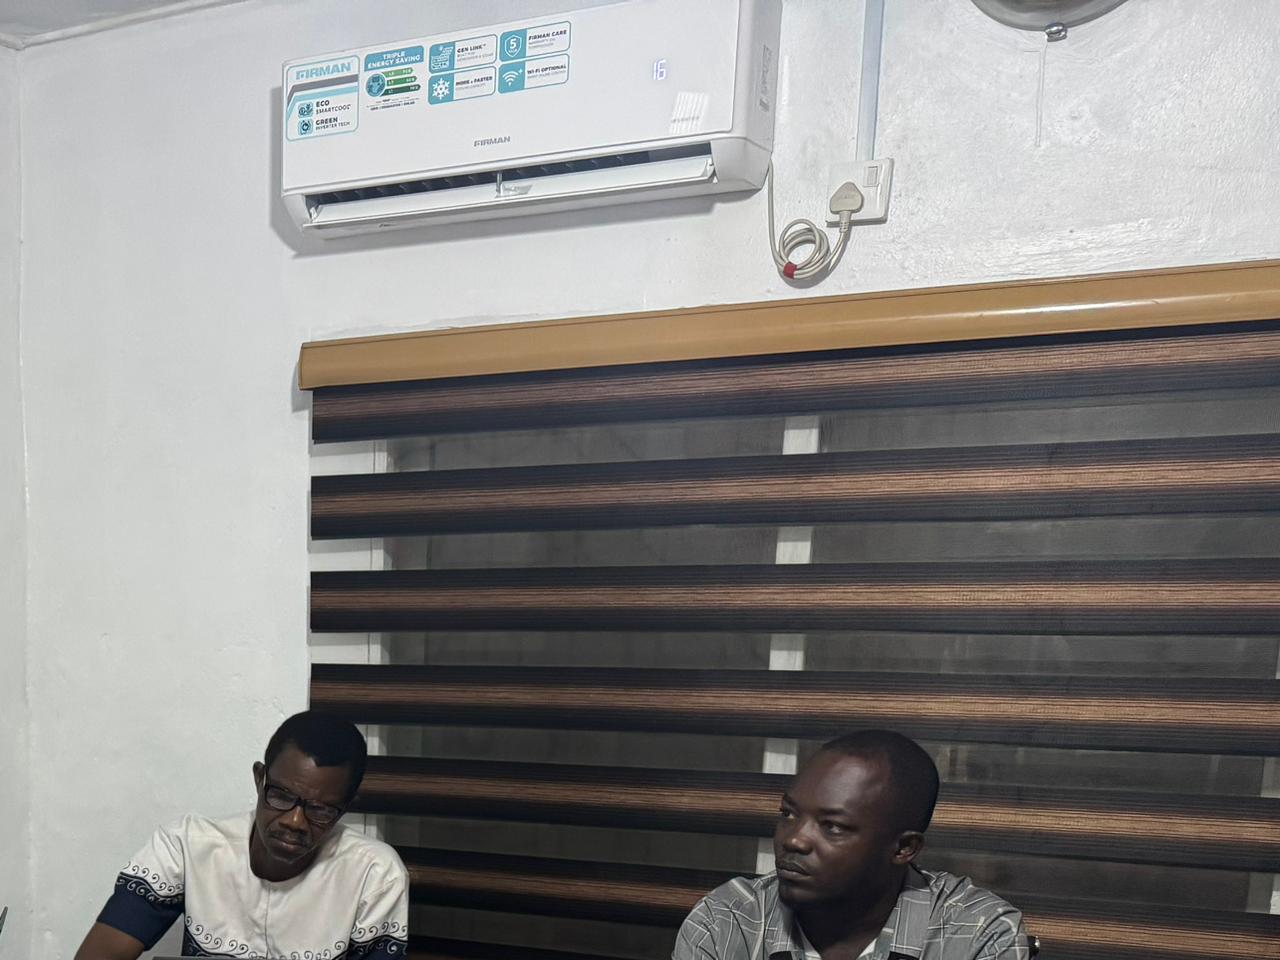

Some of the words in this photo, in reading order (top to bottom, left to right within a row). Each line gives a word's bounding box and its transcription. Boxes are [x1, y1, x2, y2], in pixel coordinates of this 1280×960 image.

[528, 32, 551, 41] FIRMAN
[552, 29, 568, 37] CARE
[510, 38, 518, 50] 5
[383, 51, 406, 60] TRIPLE
[367, 58, 395, 69] ENERGY
[396, 55, 421, 64] SAVING
[295, 62, 352, 80] FIRMAN
[653, 59, 666, 80] 16
[316, 100, 330, 108] ECO
[316, 116, 338, 126] GREEN
[473, 135, 511, 148] FIRMAN
